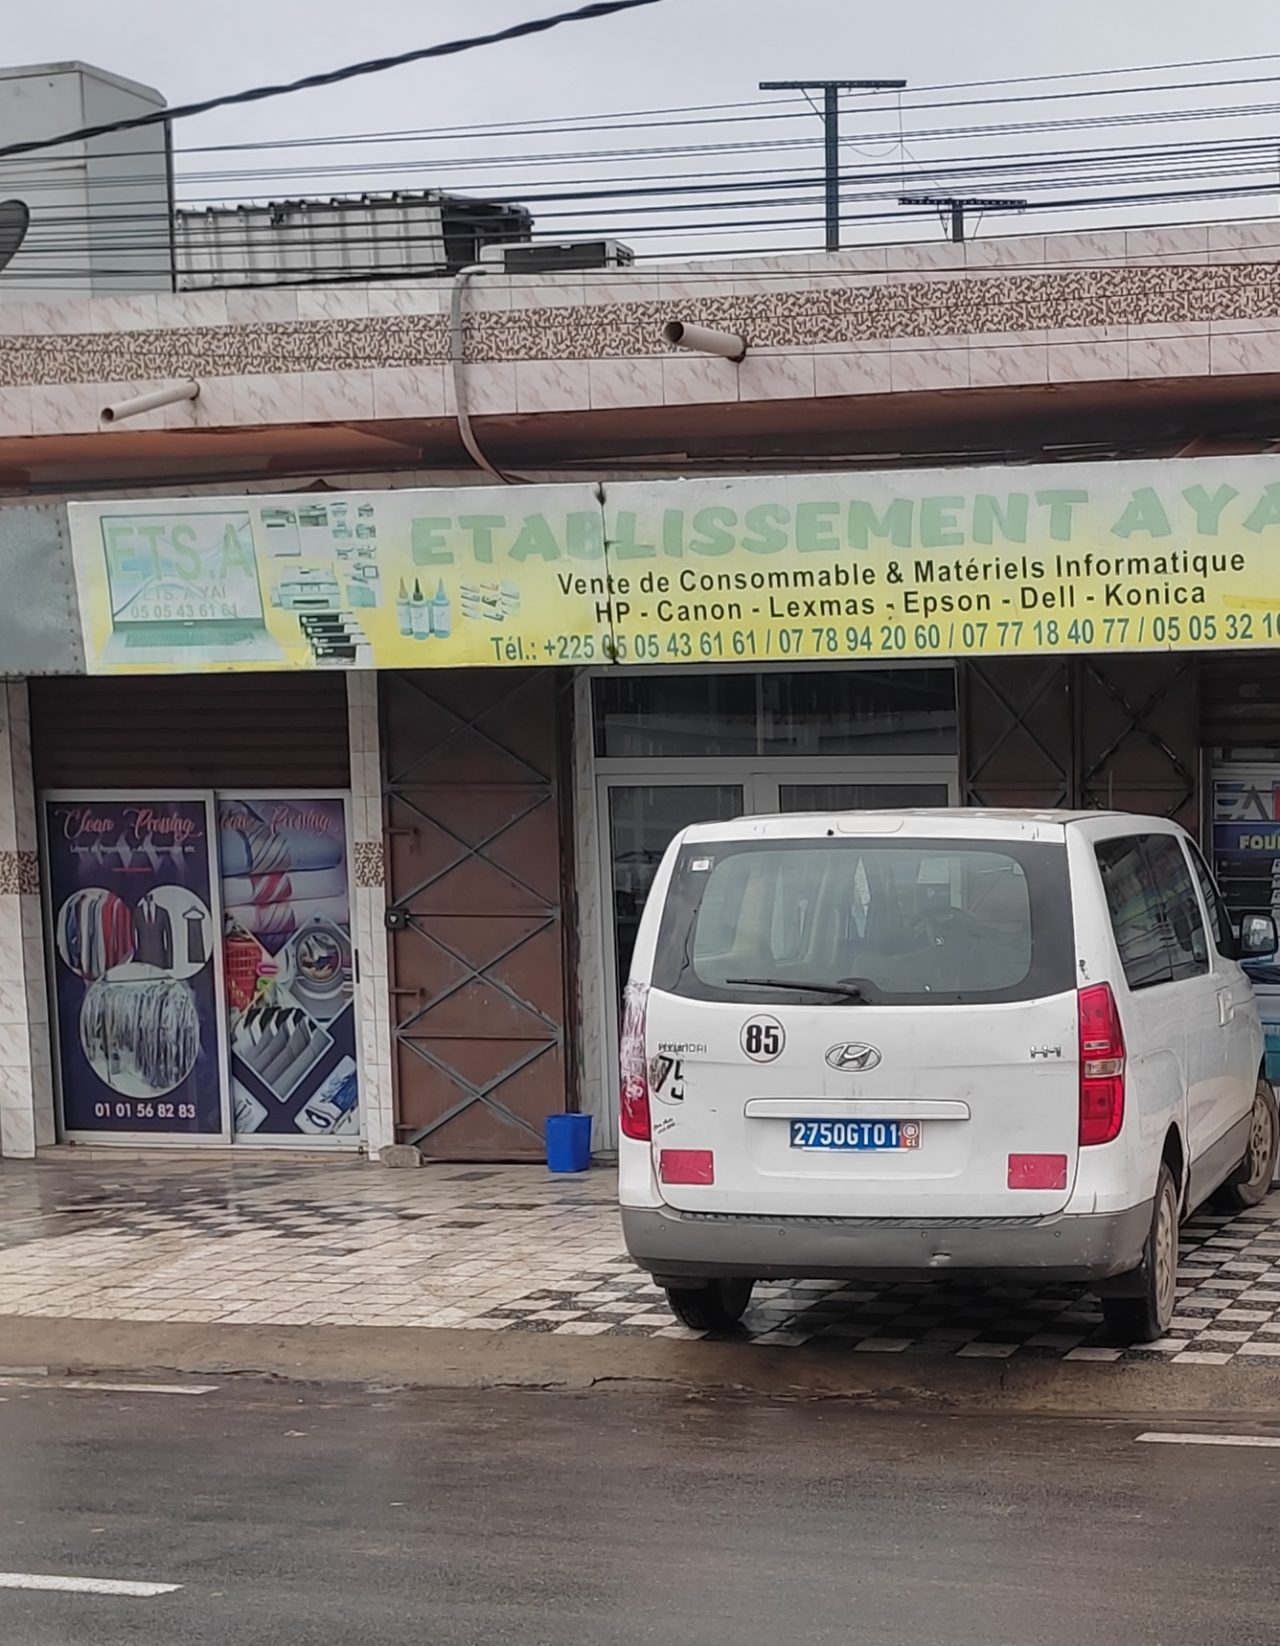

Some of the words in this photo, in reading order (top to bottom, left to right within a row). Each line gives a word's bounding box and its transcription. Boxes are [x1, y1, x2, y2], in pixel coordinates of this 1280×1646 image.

[411, 489, 1090, 566] ETABLISSEMENT
[557, 572, 630, 596] Vente
[640, 570, 669, 594] de
[679, 561, 876, 593] Consommable
[886, 561, 904, 585] &
[914, 555, 1046, 584] Matériels
[1056, 549, 1246, 580] Informatique
[131, 605, 149, 619] 05
[153, 605, 172, 618] 05
[176, 604, 194, 618] 43
[595, 600, 631, 624] HP
[657, 597, 742, 622] Canon
[770, 595, 875, 619] Lexmas
[903, 591, 992, 618] Epson
[1021, 585, 1075, 609] Dell
[1104, 582, 1206, 607] Konica
[490, 637, 537, 662] Tél.:
[543, 635, 595, 660] +225
[634, 633, 660, 658] 05
[666, 631, 693, 657] 43
[699, 631, 724, 657] 61
[732, 630, 755, 656] 61
[778, 628, 804, 654] 07
[811, 627, 838, 653] 78
[845, 626, 873, 652] 94
[880, 625, 906, 651] 20
[914, 623, 940, 649] 60
[962, 621, 989, 648] 07
[998, 620, 1024, 646] 77
[1034, 619, 1059, 645] 18
[1067, 618, 1095, 644] 40
[1103, 617, 1130, 643] 77
[1152, 615, 1181, 641] 05
[1188, 614, 1217, 640] 05
[1225, 613, 1253, 640] 32
[745, 1024, 780, 1056] 85
[95, 1103, 111, 1118] 01
[116, 1103, 132, 1118] 01
[136, 1103, 154, 1118] 56
[158, 1103, 175, 1118] 82
[178, 1104, 196, 1119] 83
